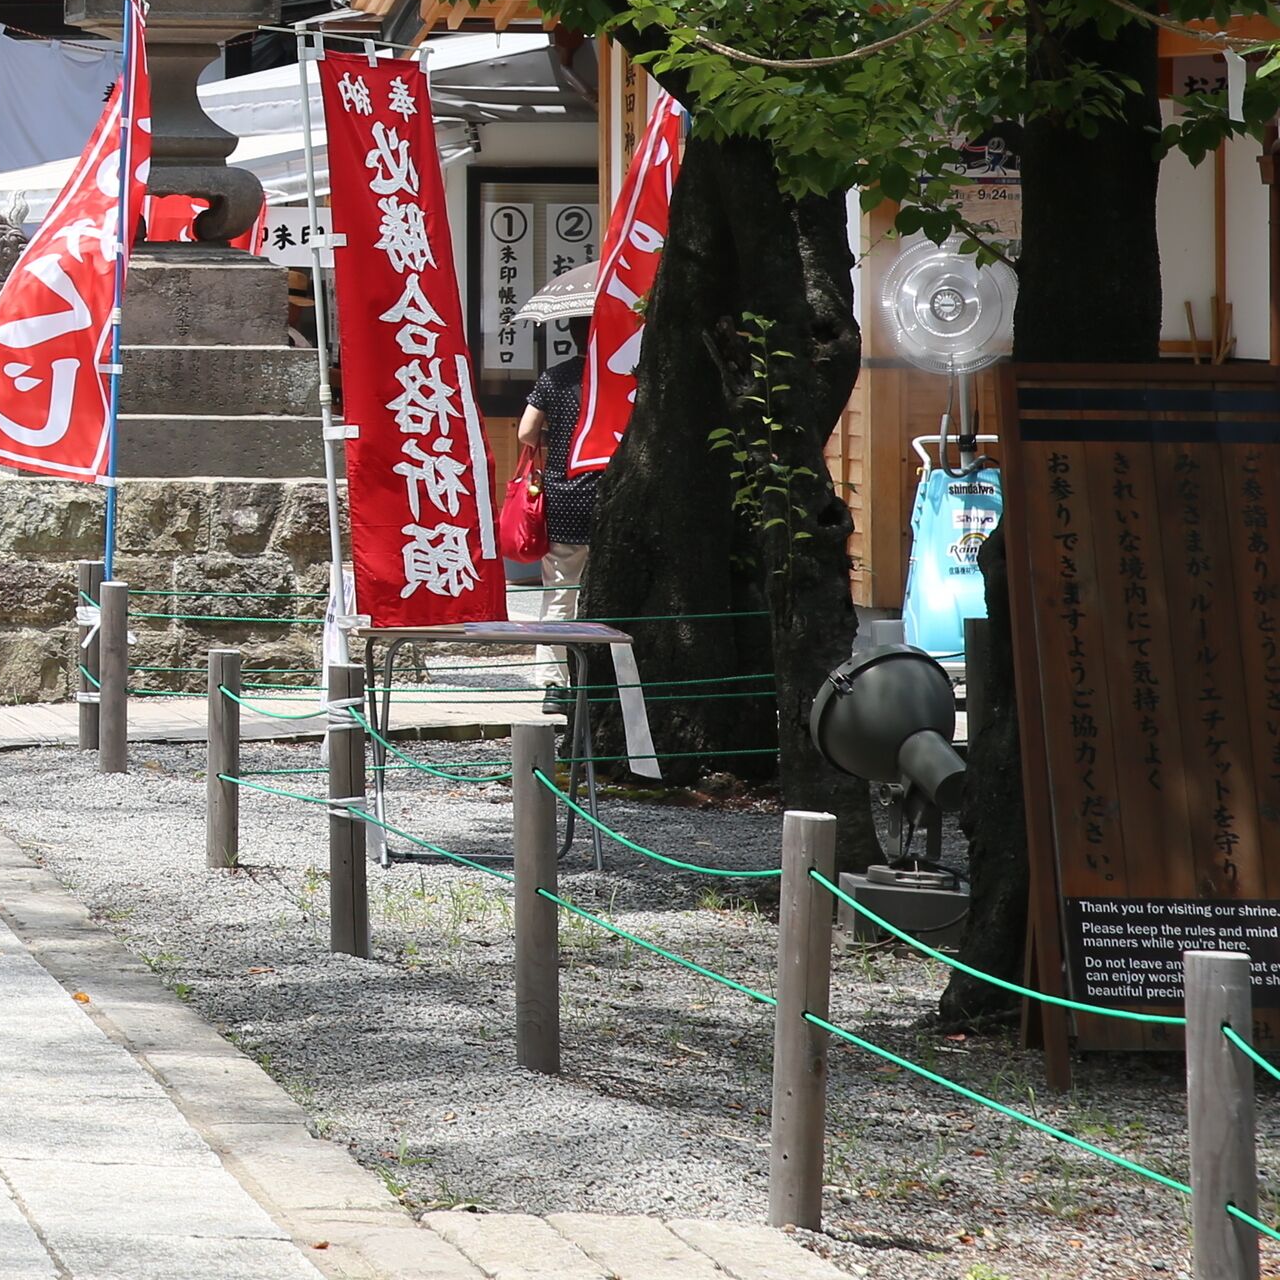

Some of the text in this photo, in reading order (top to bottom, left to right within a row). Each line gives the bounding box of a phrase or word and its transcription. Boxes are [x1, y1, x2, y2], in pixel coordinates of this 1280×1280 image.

[498, 244, 518, 364] 朱印帳受付口
[1080, 901, 1280, 917] Thank you for visiting our shrine.
[1082, 923, 1278, 938] Please keep the rules and mind
[1083, 938, 1250, 951] manners while you're here.
[1085, 957, 1102, 968] Do
[1106, 958, 1125, 968] not
[1129, 958, 1163, 969] leave
[1086, 972, 1109, 981] can
[1112, 972, 1145, 984] enjoy
[1148, 973, 1185, 983] worsh
[1088, 985, 1185, 999] beautiful precin
